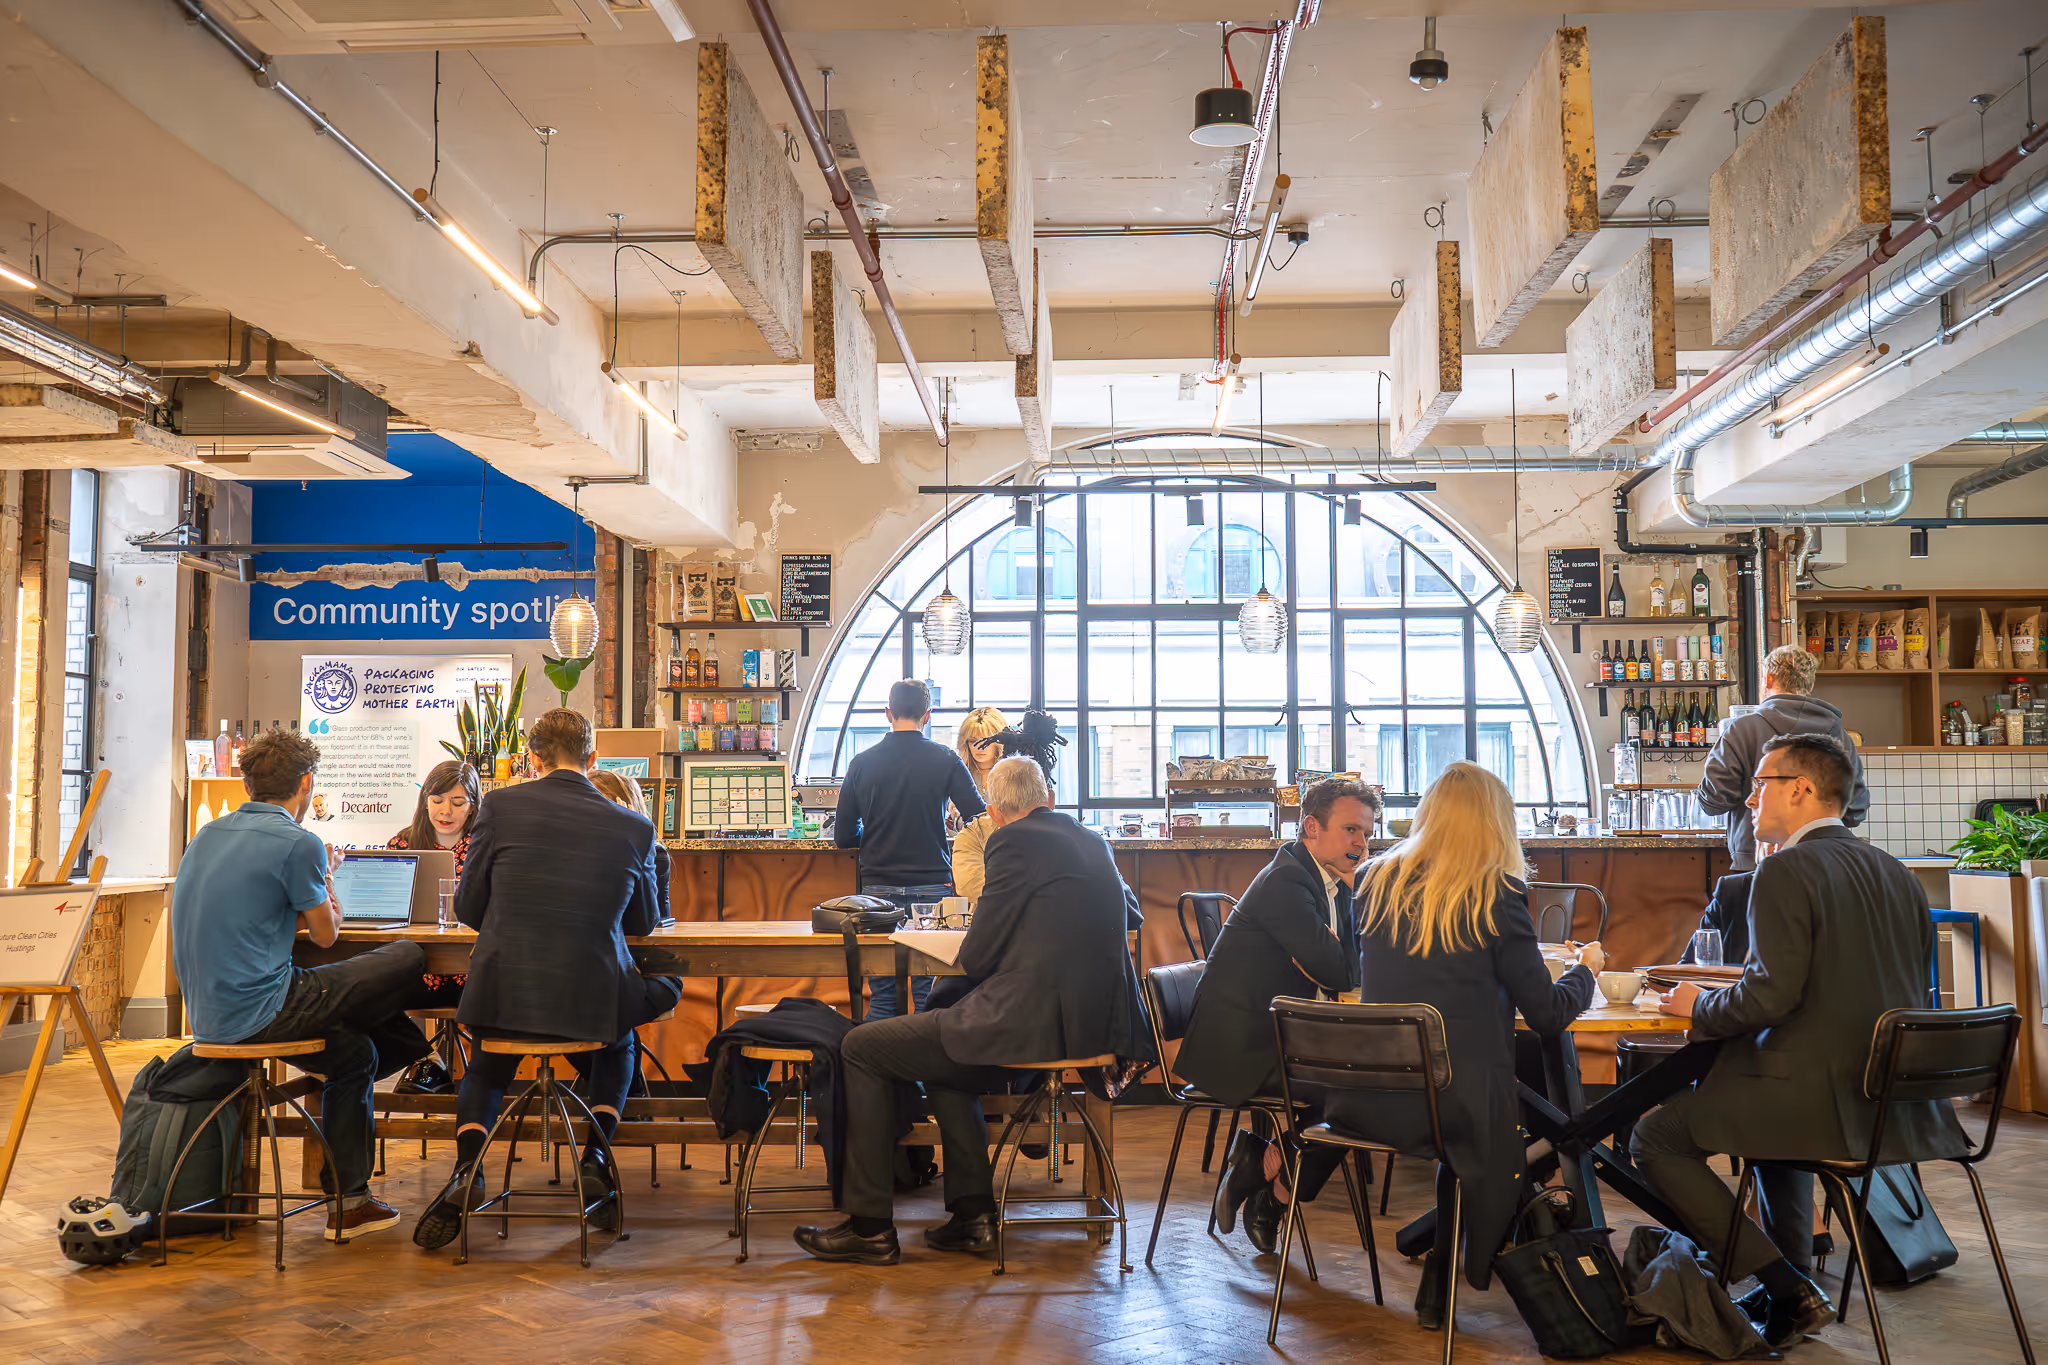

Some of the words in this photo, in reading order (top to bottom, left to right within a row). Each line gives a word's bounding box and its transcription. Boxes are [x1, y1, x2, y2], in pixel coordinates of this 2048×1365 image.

[273, 595, 460, 630] Community
[304, 661, 354, 695] PACKAMAMA
[364, 668, 435, 679] PACKAGING
[364, 684, 434, 694] PROTECTING
[363, 699, 408, 709] MOTHER
[416, 699, 455, 708] EARTH
[350, 724, 380, 733] production
[341, 801, 392, 813] Decanter
[38, 931, 57, 939] Cities
[5, 944, 36, 953] Hustings
